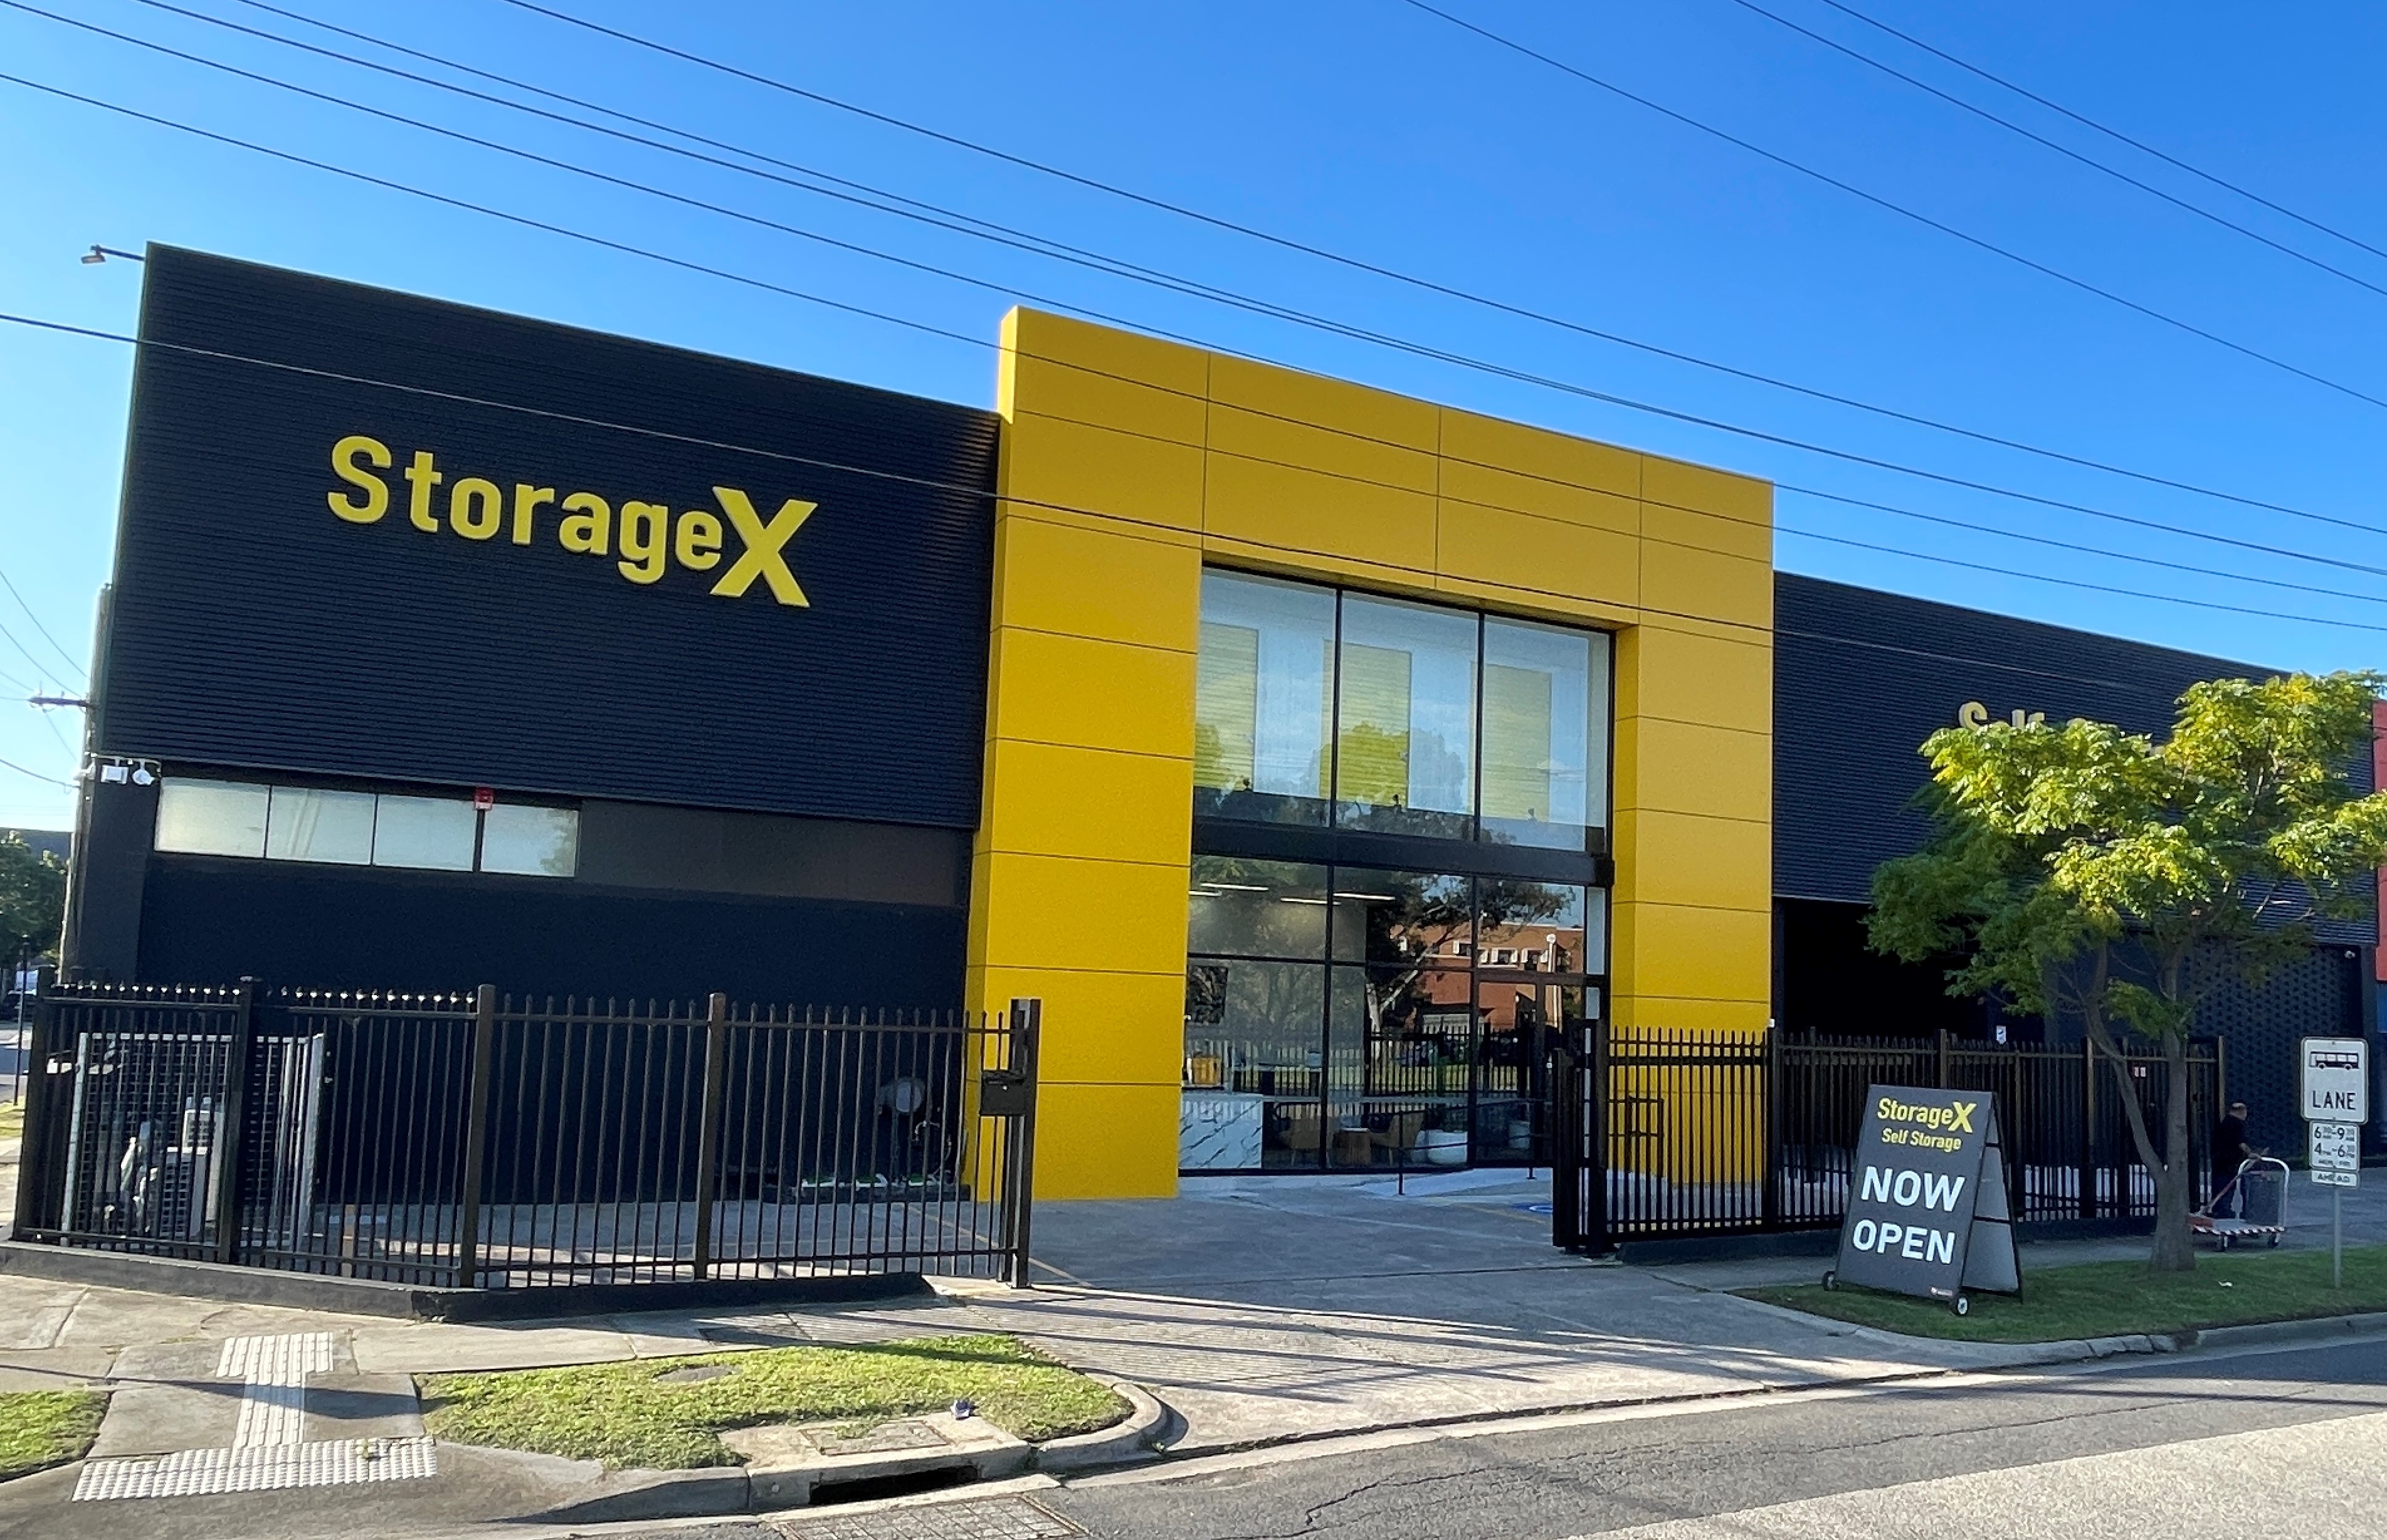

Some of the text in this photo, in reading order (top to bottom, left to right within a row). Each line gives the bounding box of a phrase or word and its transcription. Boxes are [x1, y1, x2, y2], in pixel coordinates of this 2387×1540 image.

[327, 435, 818, 607] StorageX
[1877, 1097, 1976, 1133] StorageX
[2312, 1090, 2356, 1110] LANE
[1881, 1128, 1961, 1152] Self Storage
[2337, 1128, 2345, 1140] 9
[1861, 1166, 1965, 1211] NOW
[1852, 1219, 1956, 1265] OPEN
